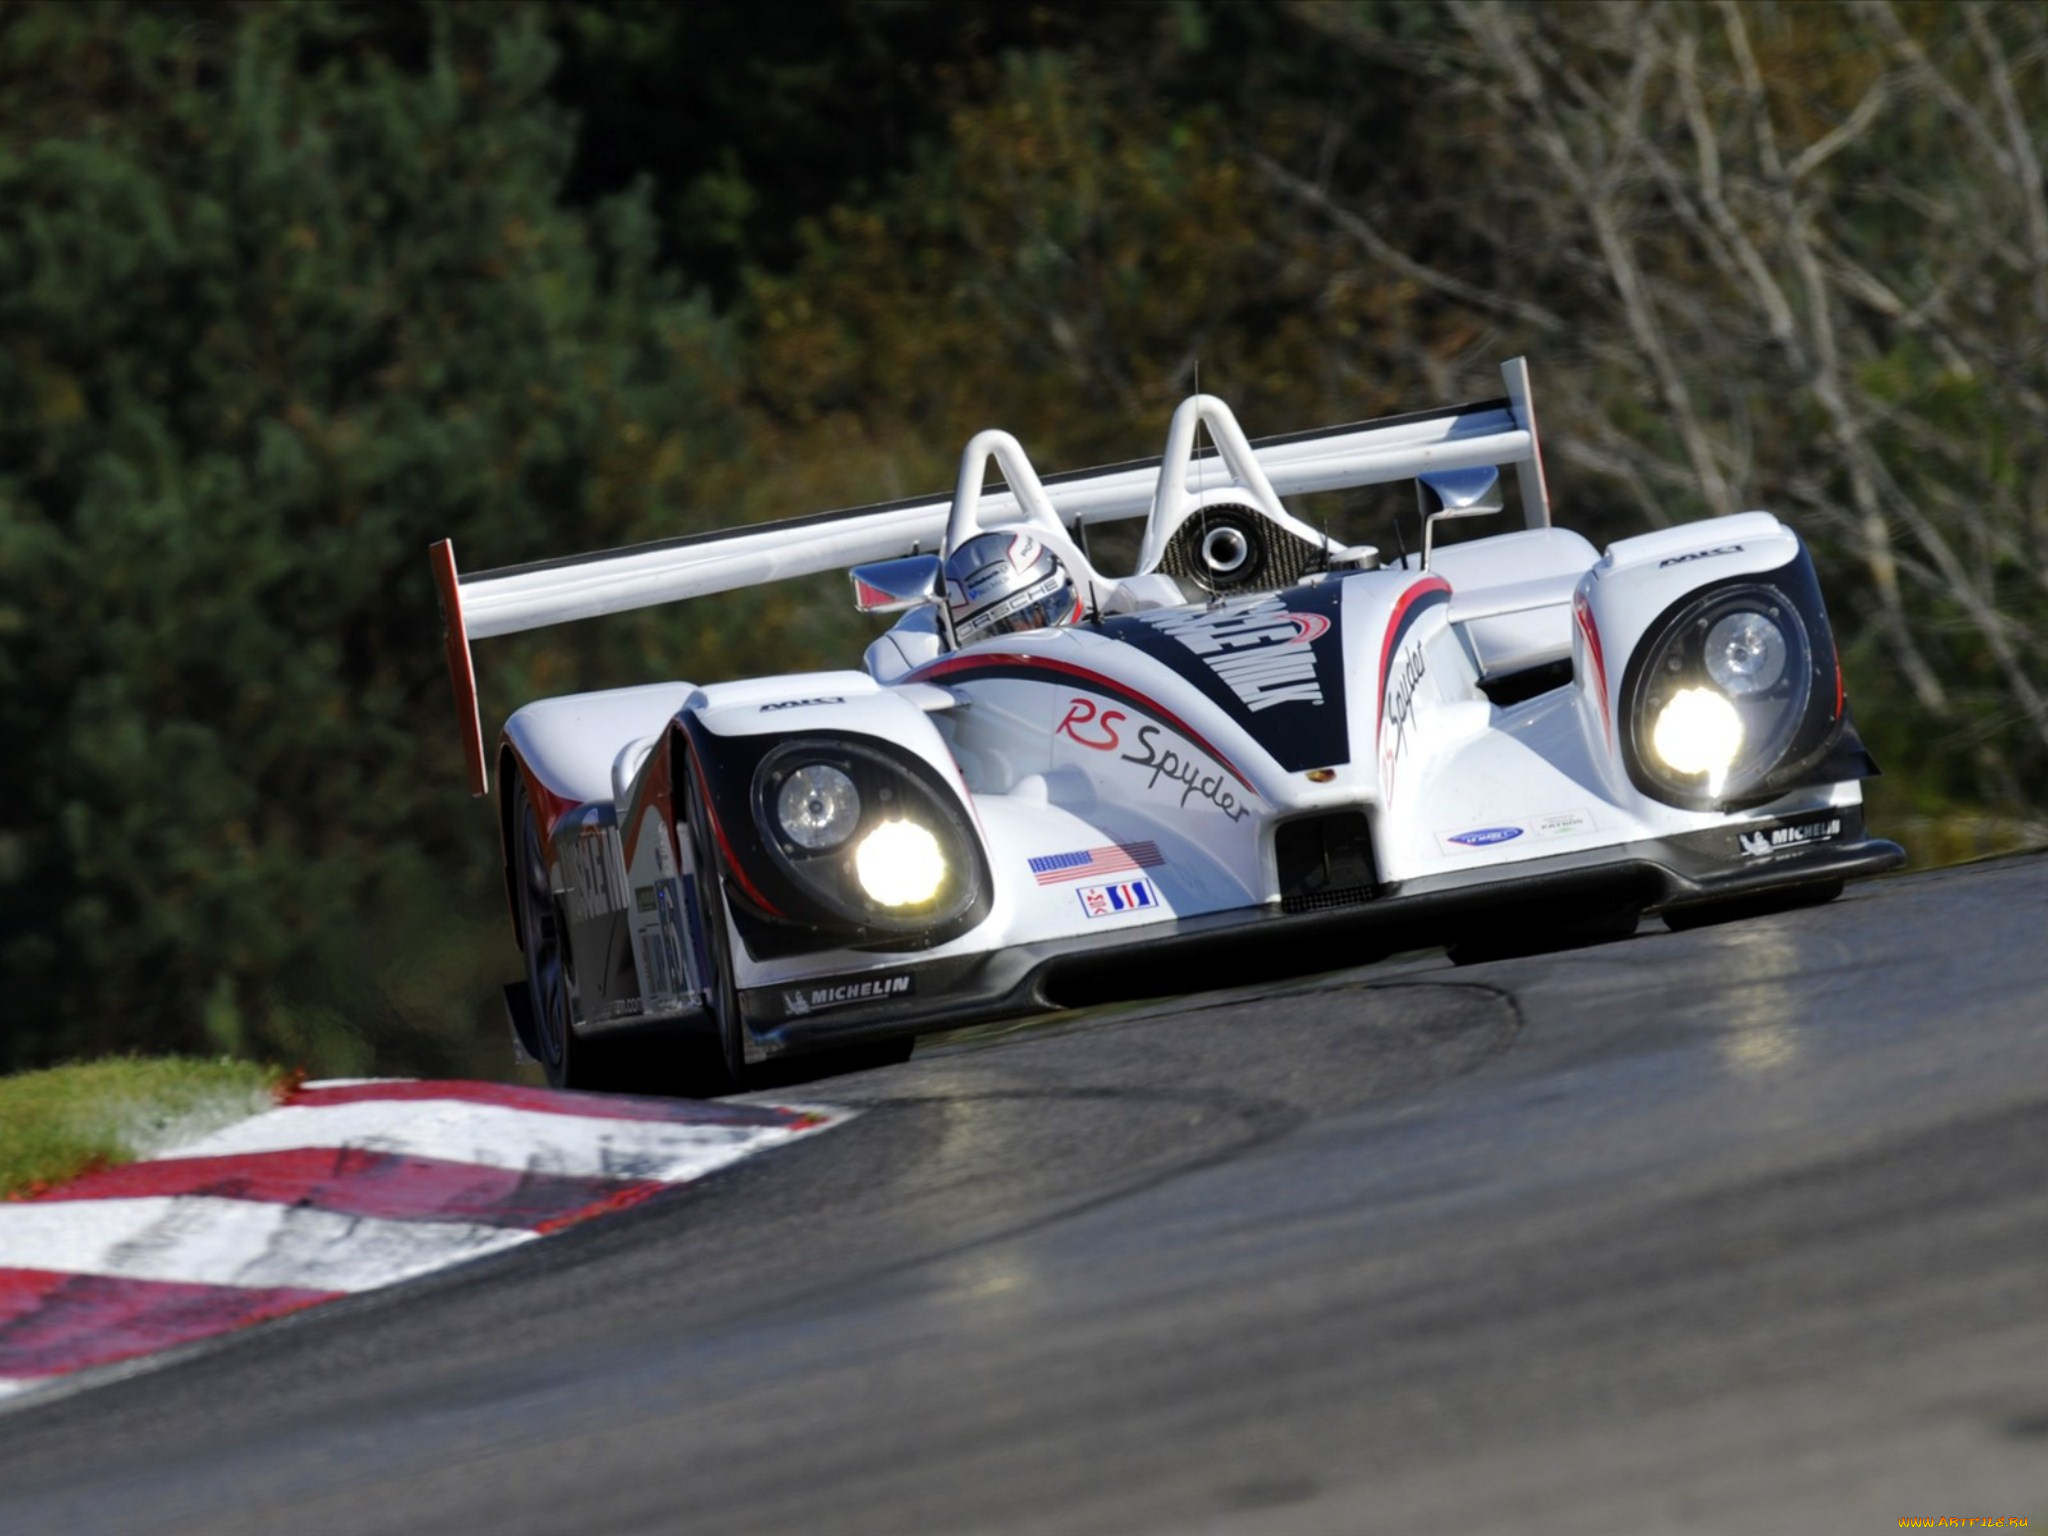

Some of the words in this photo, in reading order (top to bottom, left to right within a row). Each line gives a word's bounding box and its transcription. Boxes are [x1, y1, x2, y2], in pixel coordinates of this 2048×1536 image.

[957, 578, 1059, 638] ORSCHE
[1202, 640, 1323, 712] MILK
[1056, 698, 1127, 752] RS
[1121, 725, 1250, 823] Spyder
[1772, 819, 1840, 845] MICHELIN
[812, 976, 910, 1004] MICHELIN
